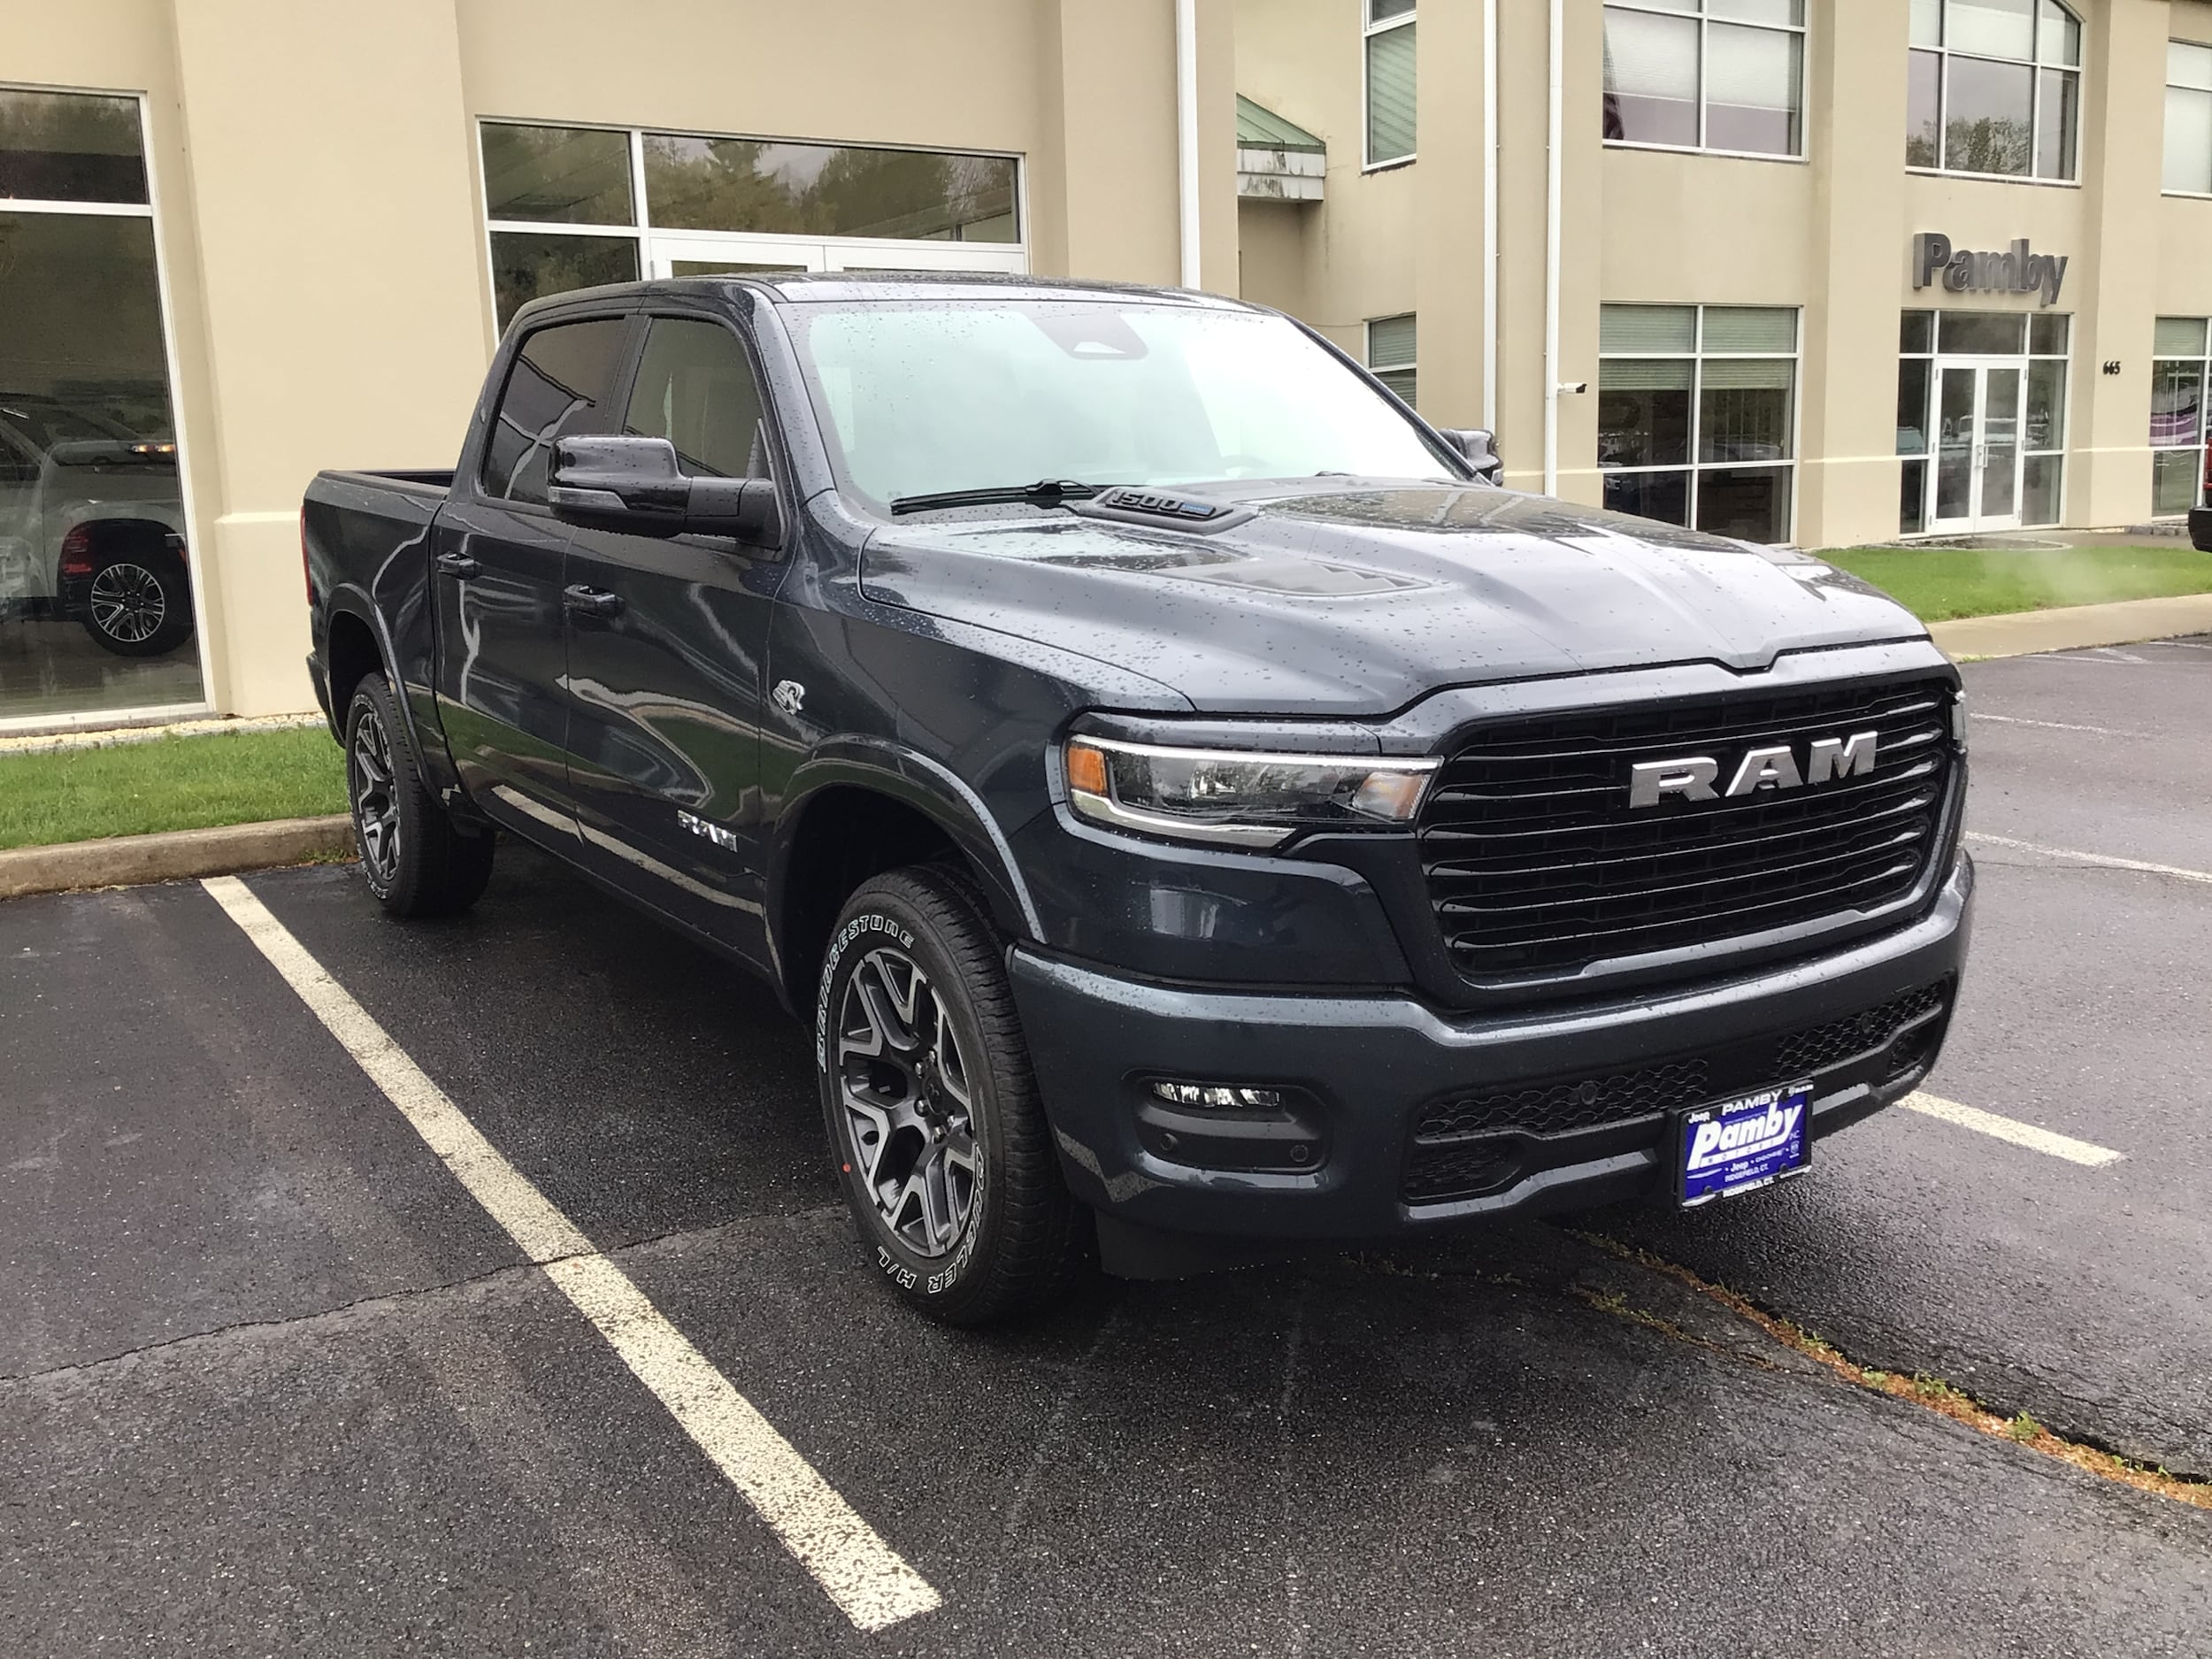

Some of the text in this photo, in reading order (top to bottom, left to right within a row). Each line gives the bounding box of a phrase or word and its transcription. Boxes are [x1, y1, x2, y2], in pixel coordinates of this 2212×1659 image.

[1913, 233, 2069, 306] Pamby
[2102, 361, 2121, 375] 665
[1112, 490, 1182, 512] 1500
[1630, 730, 1878, 809] RAM
[817, 915, 916, 1073] BRIDGESTONE
[1686, 1102, 1803, 1171] Pamby
[1722, 1089, 1783, 1116] PAMBY
[878, 1143, 985, 1294] DUELER H/L
